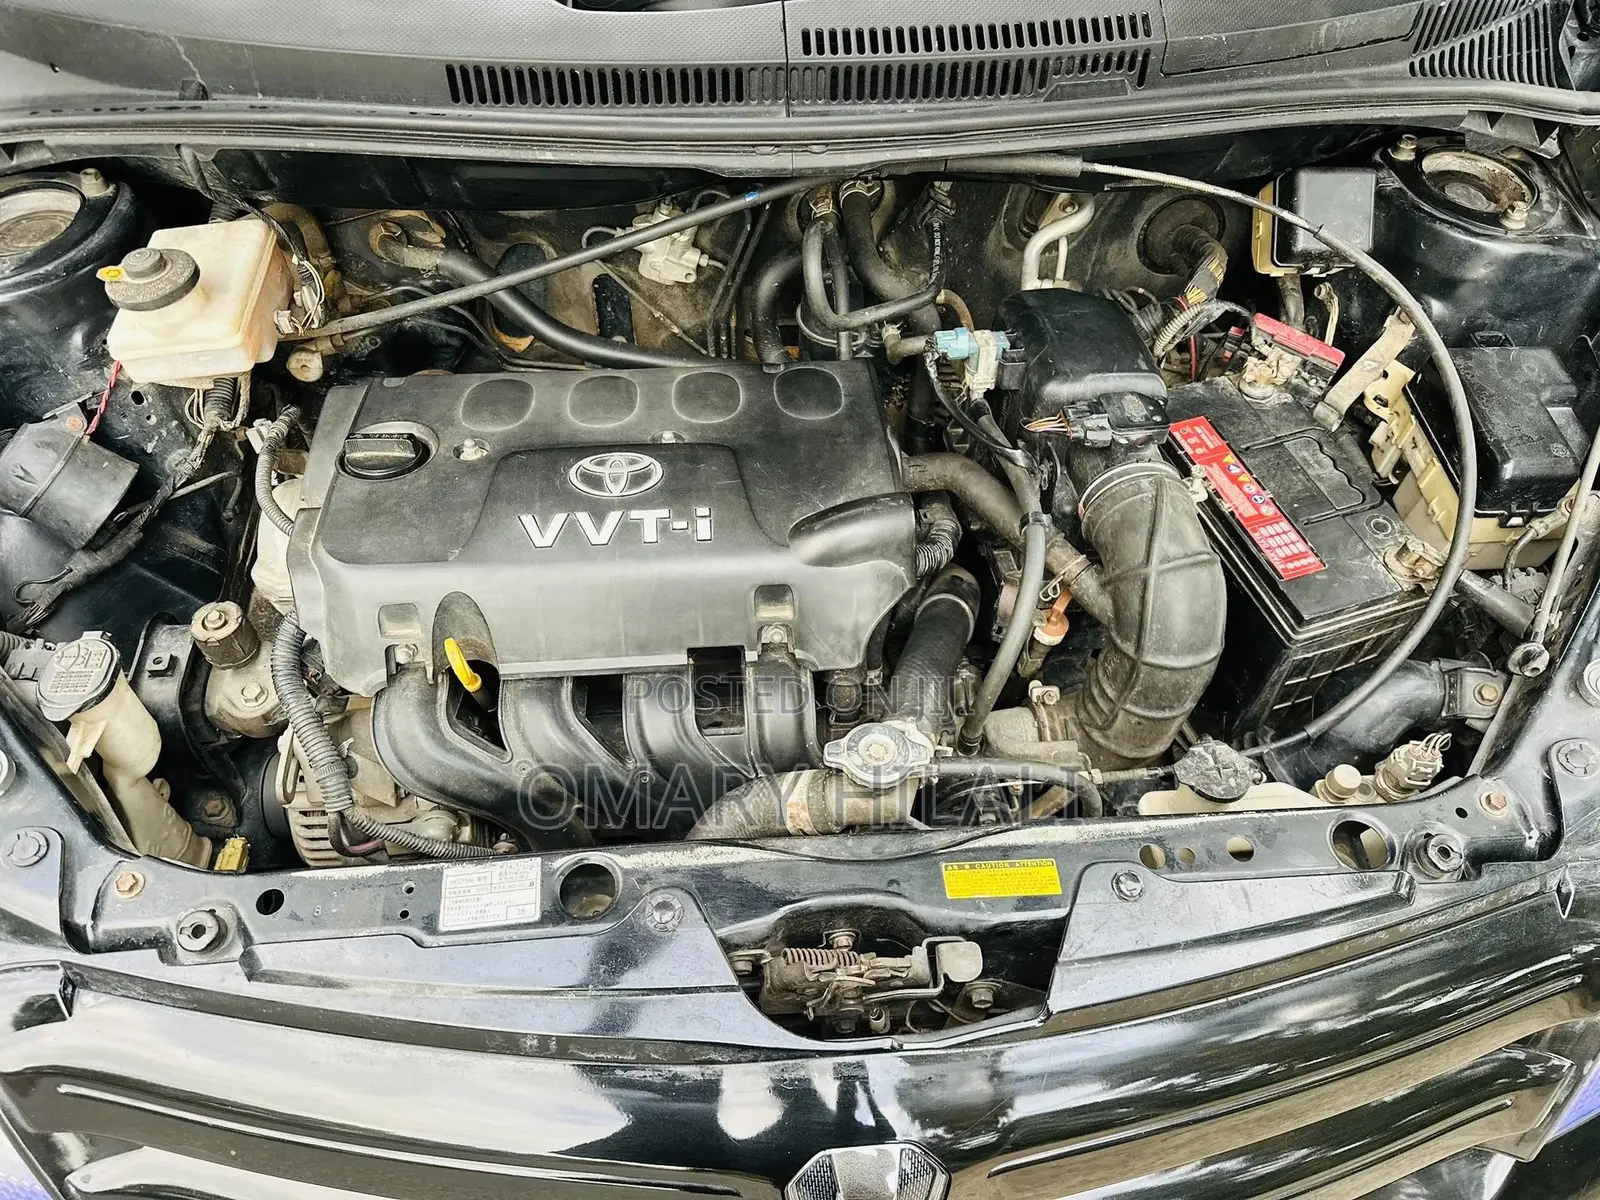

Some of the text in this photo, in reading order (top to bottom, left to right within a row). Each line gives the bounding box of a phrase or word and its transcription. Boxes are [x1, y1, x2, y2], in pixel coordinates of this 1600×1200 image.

[517, 506, 713, 549] VVT-i
[975, 861, 1010, 869] CAUTION
[1015, 860, 1053, 868] ATTENTION
